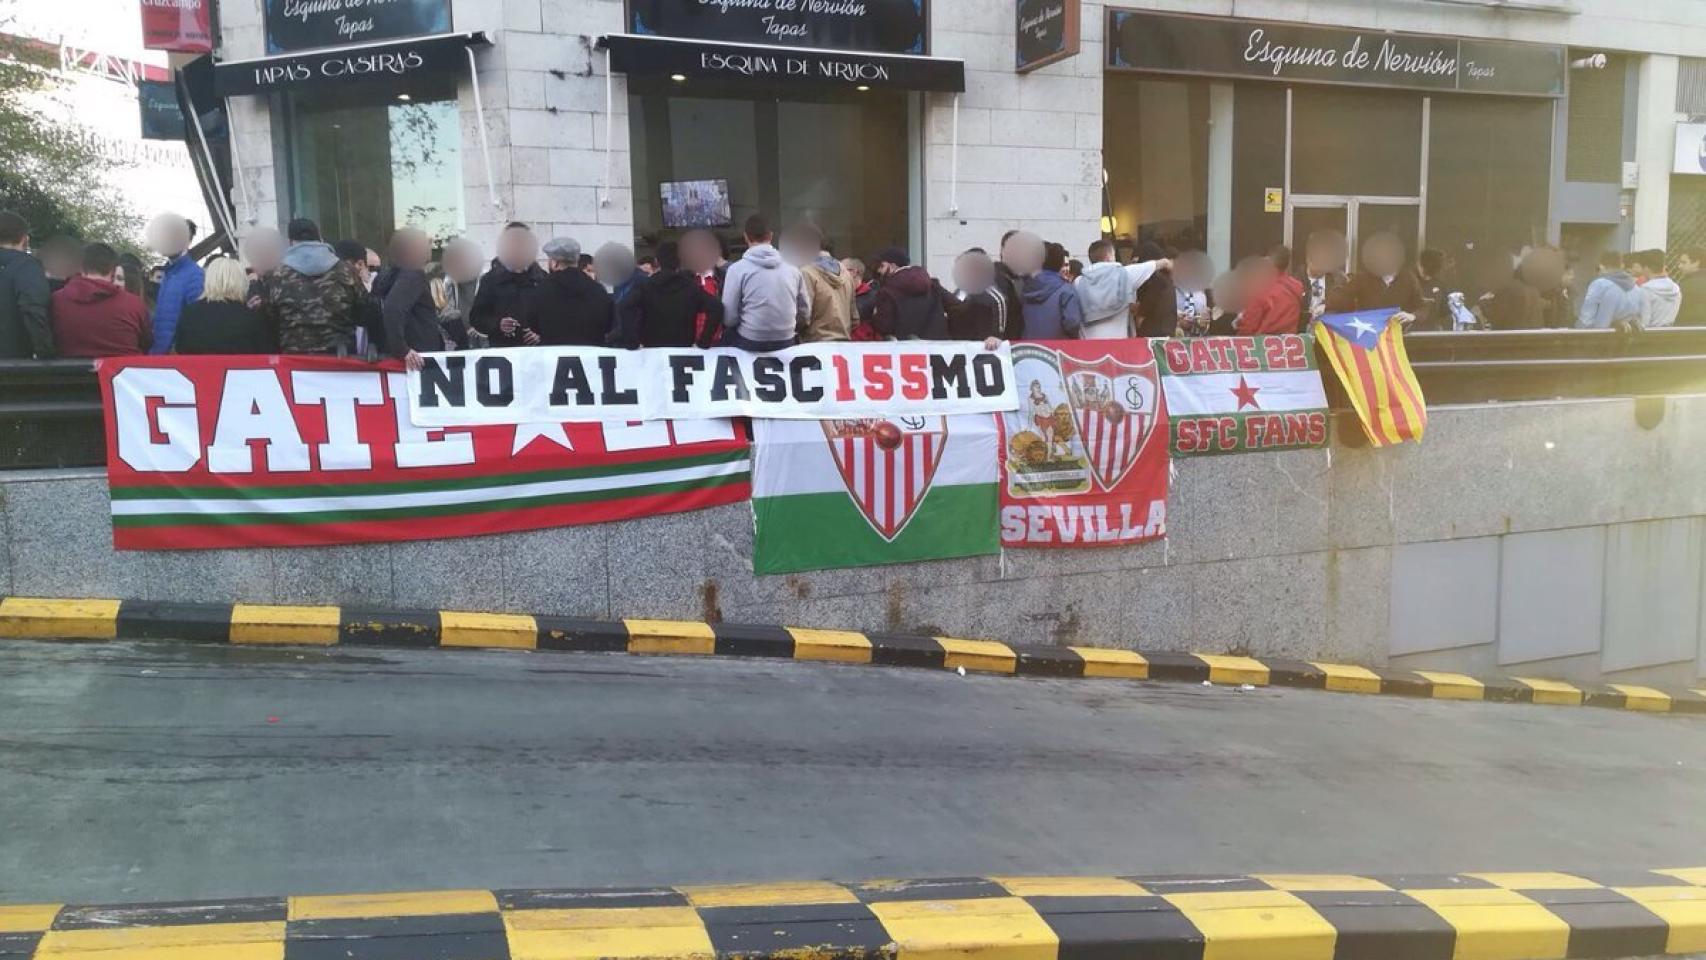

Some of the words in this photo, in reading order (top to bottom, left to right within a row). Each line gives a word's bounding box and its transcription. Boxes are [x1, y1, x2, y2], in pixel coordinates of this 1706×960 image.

[335, 15, 374, 39] Tapas
[761, 15, 808, 40] Tapas
[321, 51, 423, 76] CASERAS
[701, 52, 778, 75] ESQUINA
[787, 59, 809, 75] DE
[1244, 29, 1337, 75] Esquina
[1342, 36, 1370, 69] de
[1373, 39, 1456, 76] Nervión
[1466, 61, 1496, 80] Tapas
[1164, 336, 1261, 375] GATE
[1264, 335, 1308, 370] 22
[419, 356, 514, 407] NO
[549, 356, 638, 406] AL
[669, 353, 1006, 403] FASC155MO
[1177, 417, 1238, 452] SFC
[1245, 412, 1326, 449] FANS
[1001, 500, 1166, 543] SEVILLA
